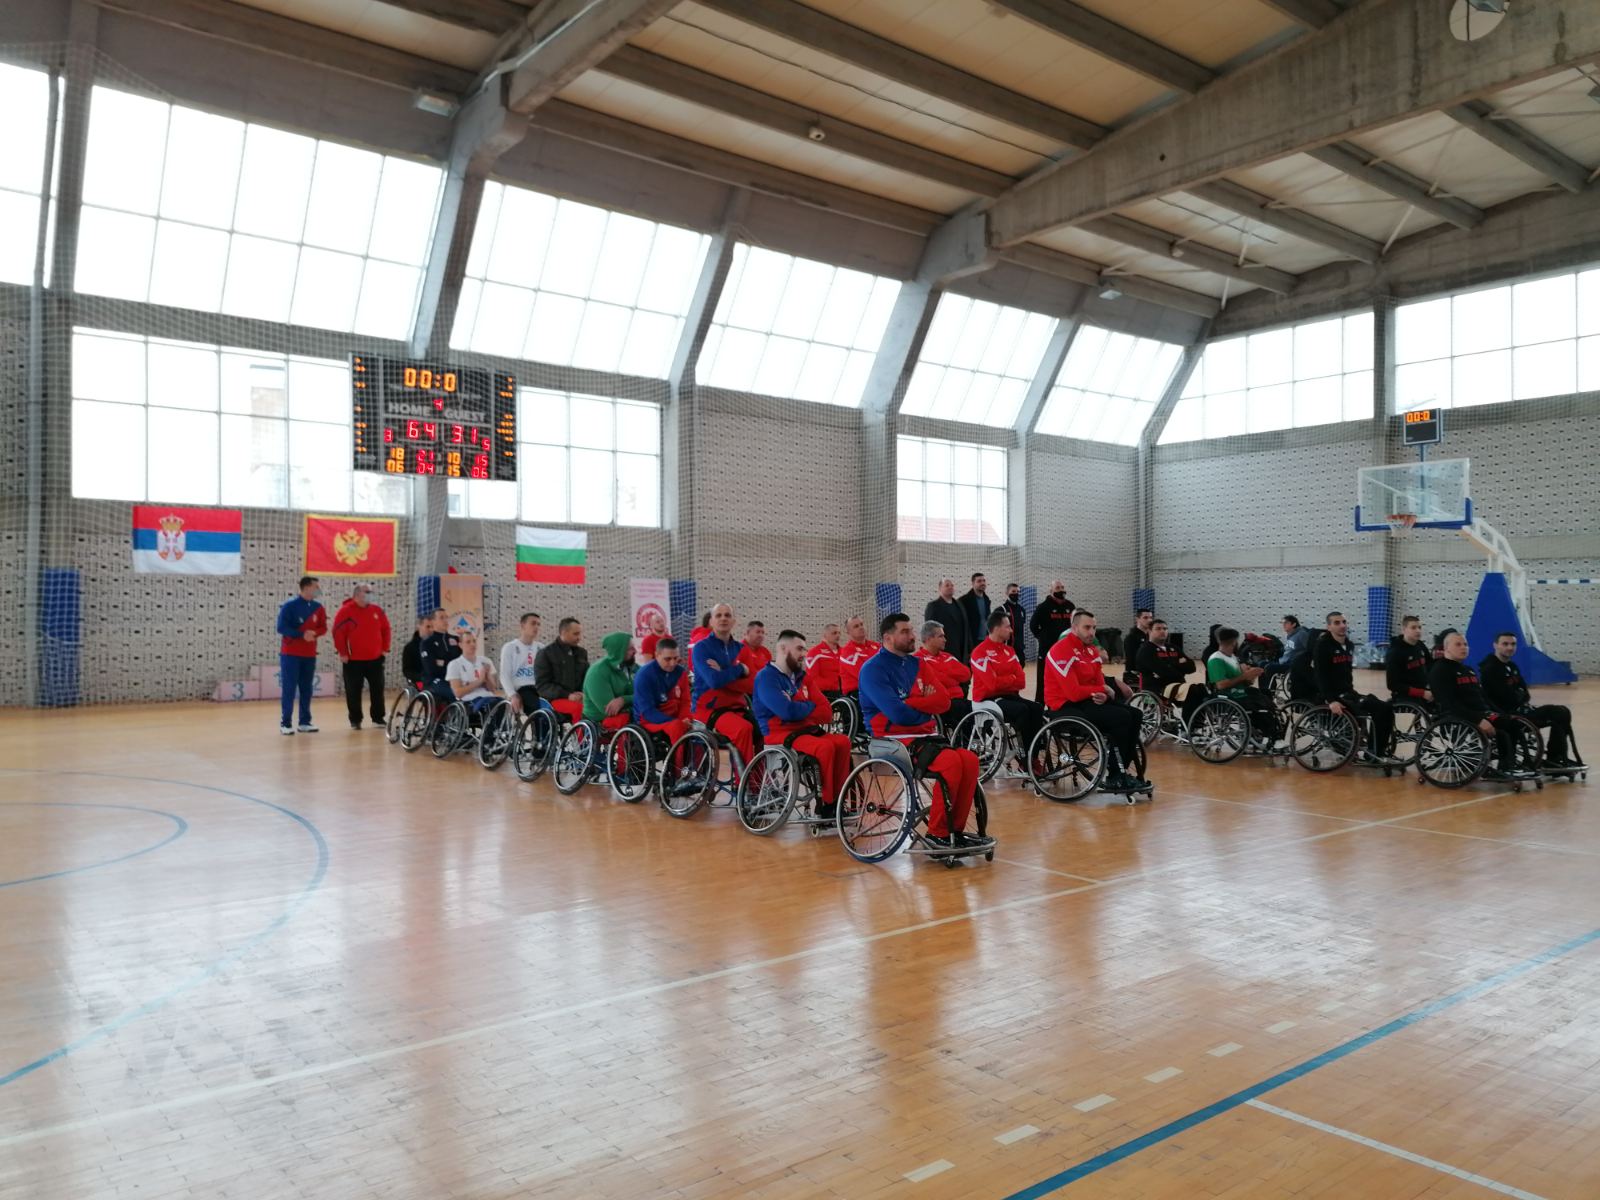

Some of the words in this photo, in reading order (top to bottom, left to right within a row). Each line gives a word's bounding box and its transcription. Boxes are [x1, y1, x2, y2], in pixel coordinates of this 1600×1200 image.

[404, 367, 456, 392] 00:0
[389, 403, 431, 416] HOME
[444, 409, 486, 422] GUEST
[407, 420, 435, 440] 64
[452, 424, 478, 445] 31
[232, 682, 244, 700] 3
